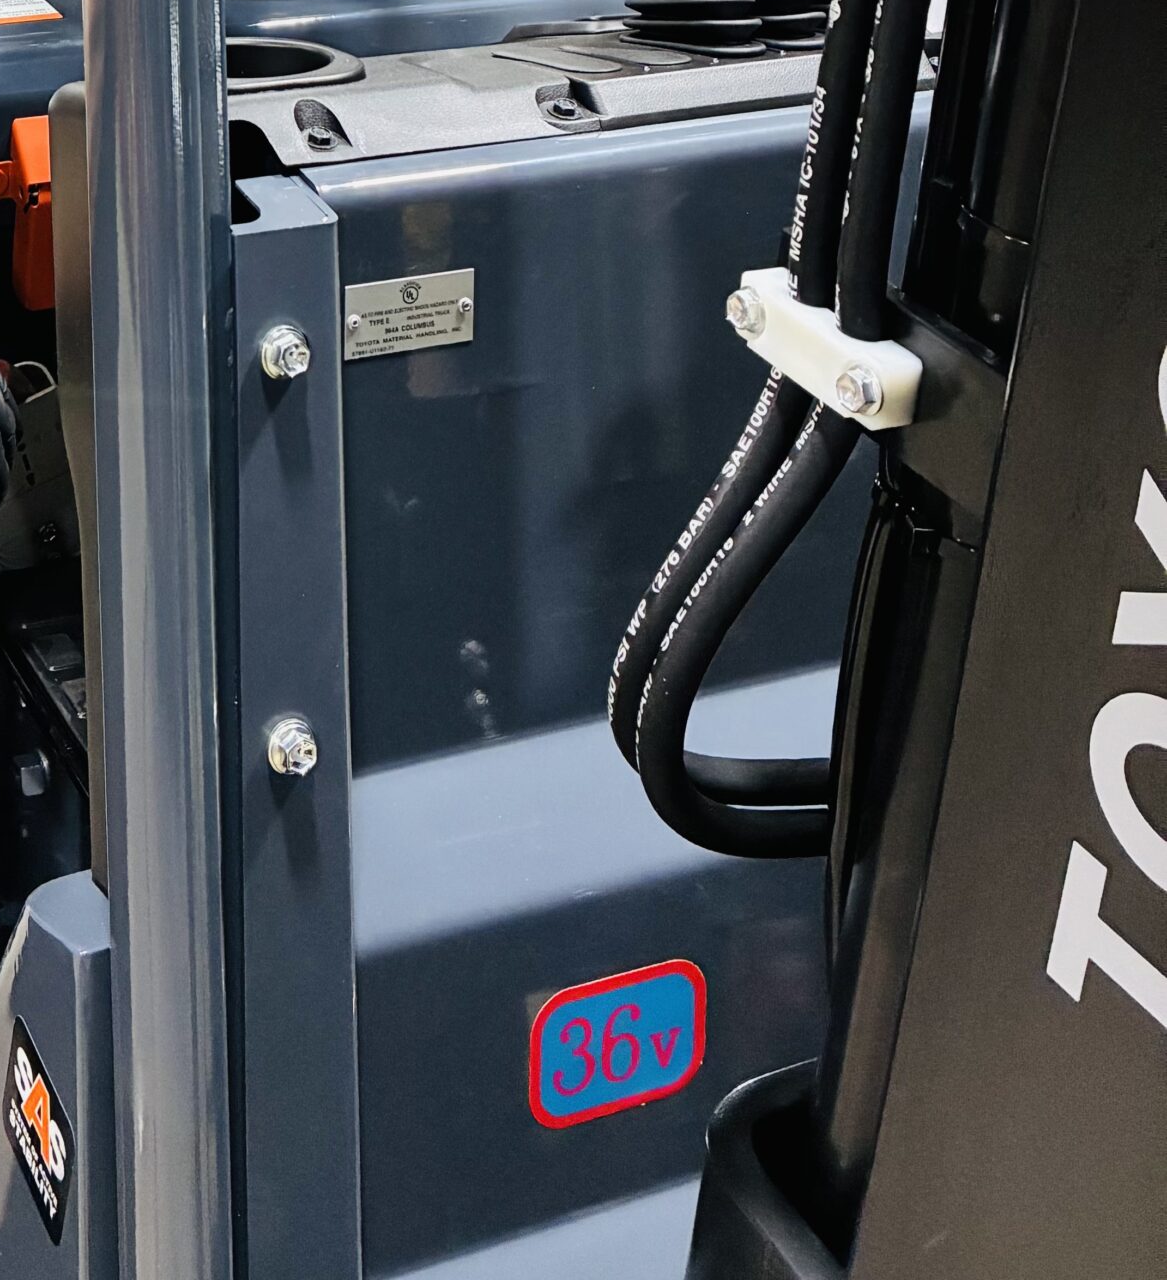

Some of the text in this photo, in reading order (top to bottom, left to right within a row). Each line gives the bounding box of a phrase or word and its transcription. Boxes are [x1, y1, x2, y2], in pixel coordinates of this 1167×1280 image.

[789, 193, 809, 262] MSHA
[382, 334, 413, 344] MATERIAL
[401, 320, 435, 331] COLUMBUS
[613, 636, 630, 677] PSI
[627, 598, 647, 636] WP
[651, 550, 680, 594] (276
[678, 496, 714, 550] BAR)
[722, 365, 782, 478] SAE100R16
[14, 1046, 67, 1183] SAS
[8, 1108, 57, 1220] STABILITY
